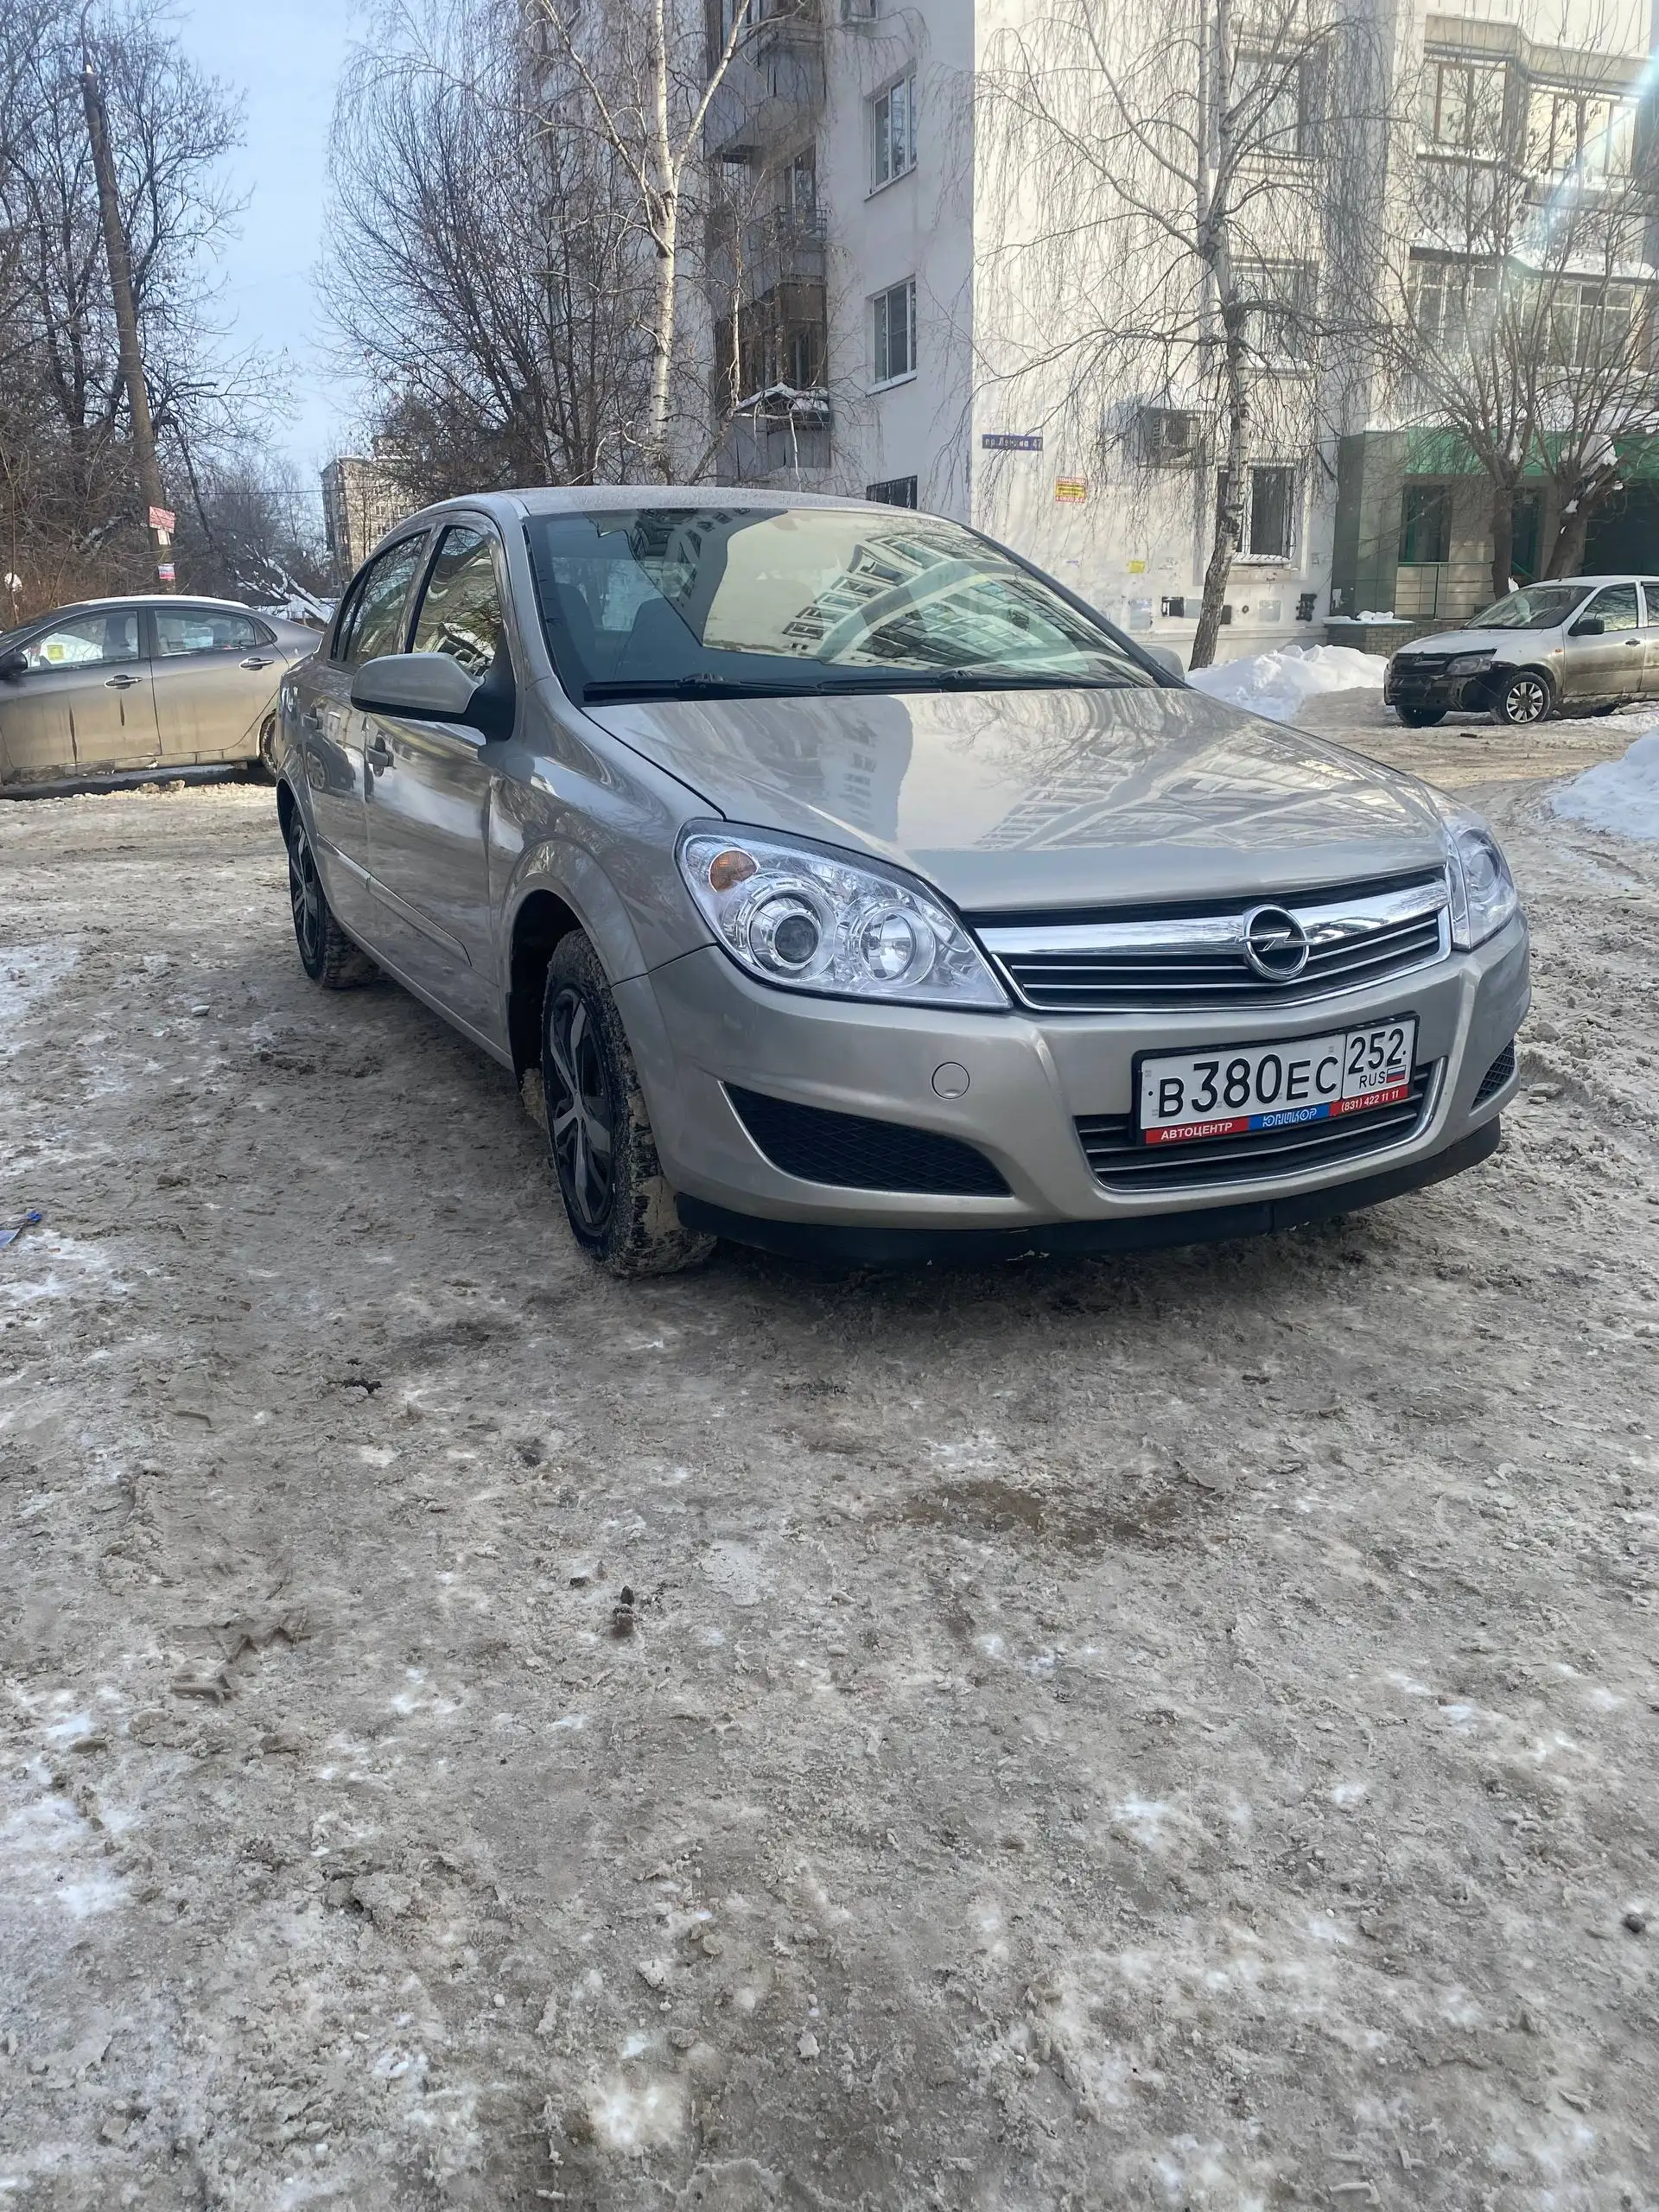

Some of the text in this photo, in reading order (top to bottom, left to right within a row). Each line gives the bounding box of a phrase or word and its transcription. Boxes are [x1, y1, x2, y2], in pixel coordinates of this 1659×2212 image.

[1033, 438, 1042, 449] 47
[1158, 1027, 1404, 1118] В380ЕС 252
[1359, 1071, 1386, 1090] RUS
[1160, 1122, 1233, 1141] АВТОЦЕНТР
[1341, 1097, 1363, 1113] (831)
[1363, 1094, 1380, 1107] 422
[1382, 1092, 1389, 1103] 11
[1392, 1090, 1400, 1100] 11
